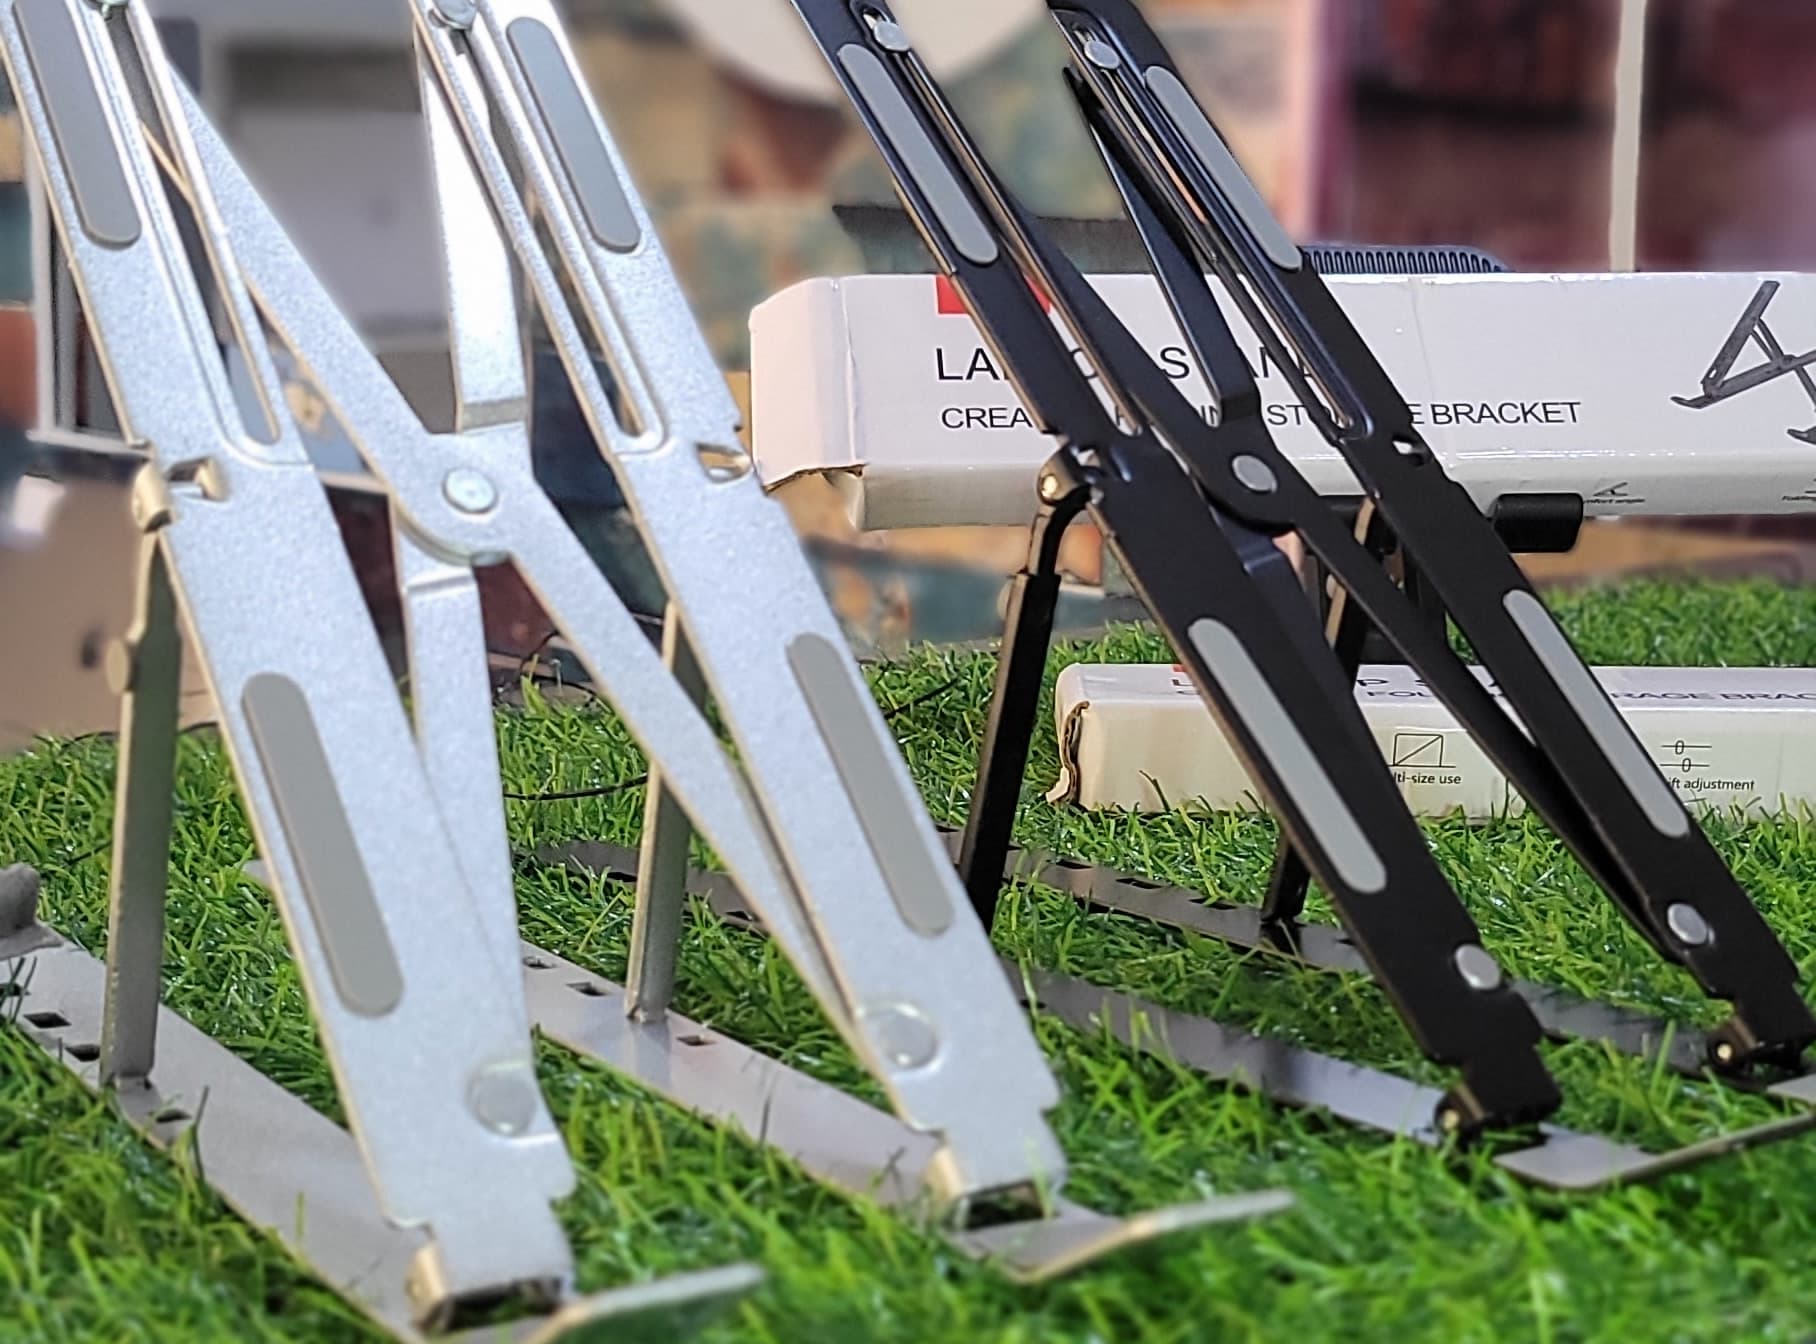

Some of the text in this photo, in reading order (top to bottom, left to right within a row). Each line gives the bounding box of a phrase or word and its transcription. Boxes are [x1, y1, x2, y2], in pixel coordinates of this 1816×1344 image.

[940, 407, 1034, 429] CREA
[1431, 401, 1582, 425] BRACKET
[1610, 692, 1816, 700] RAGE BRAC
[1439, 774, 1462, 785] use
[1683, 777, 1755, 794] adjustment
